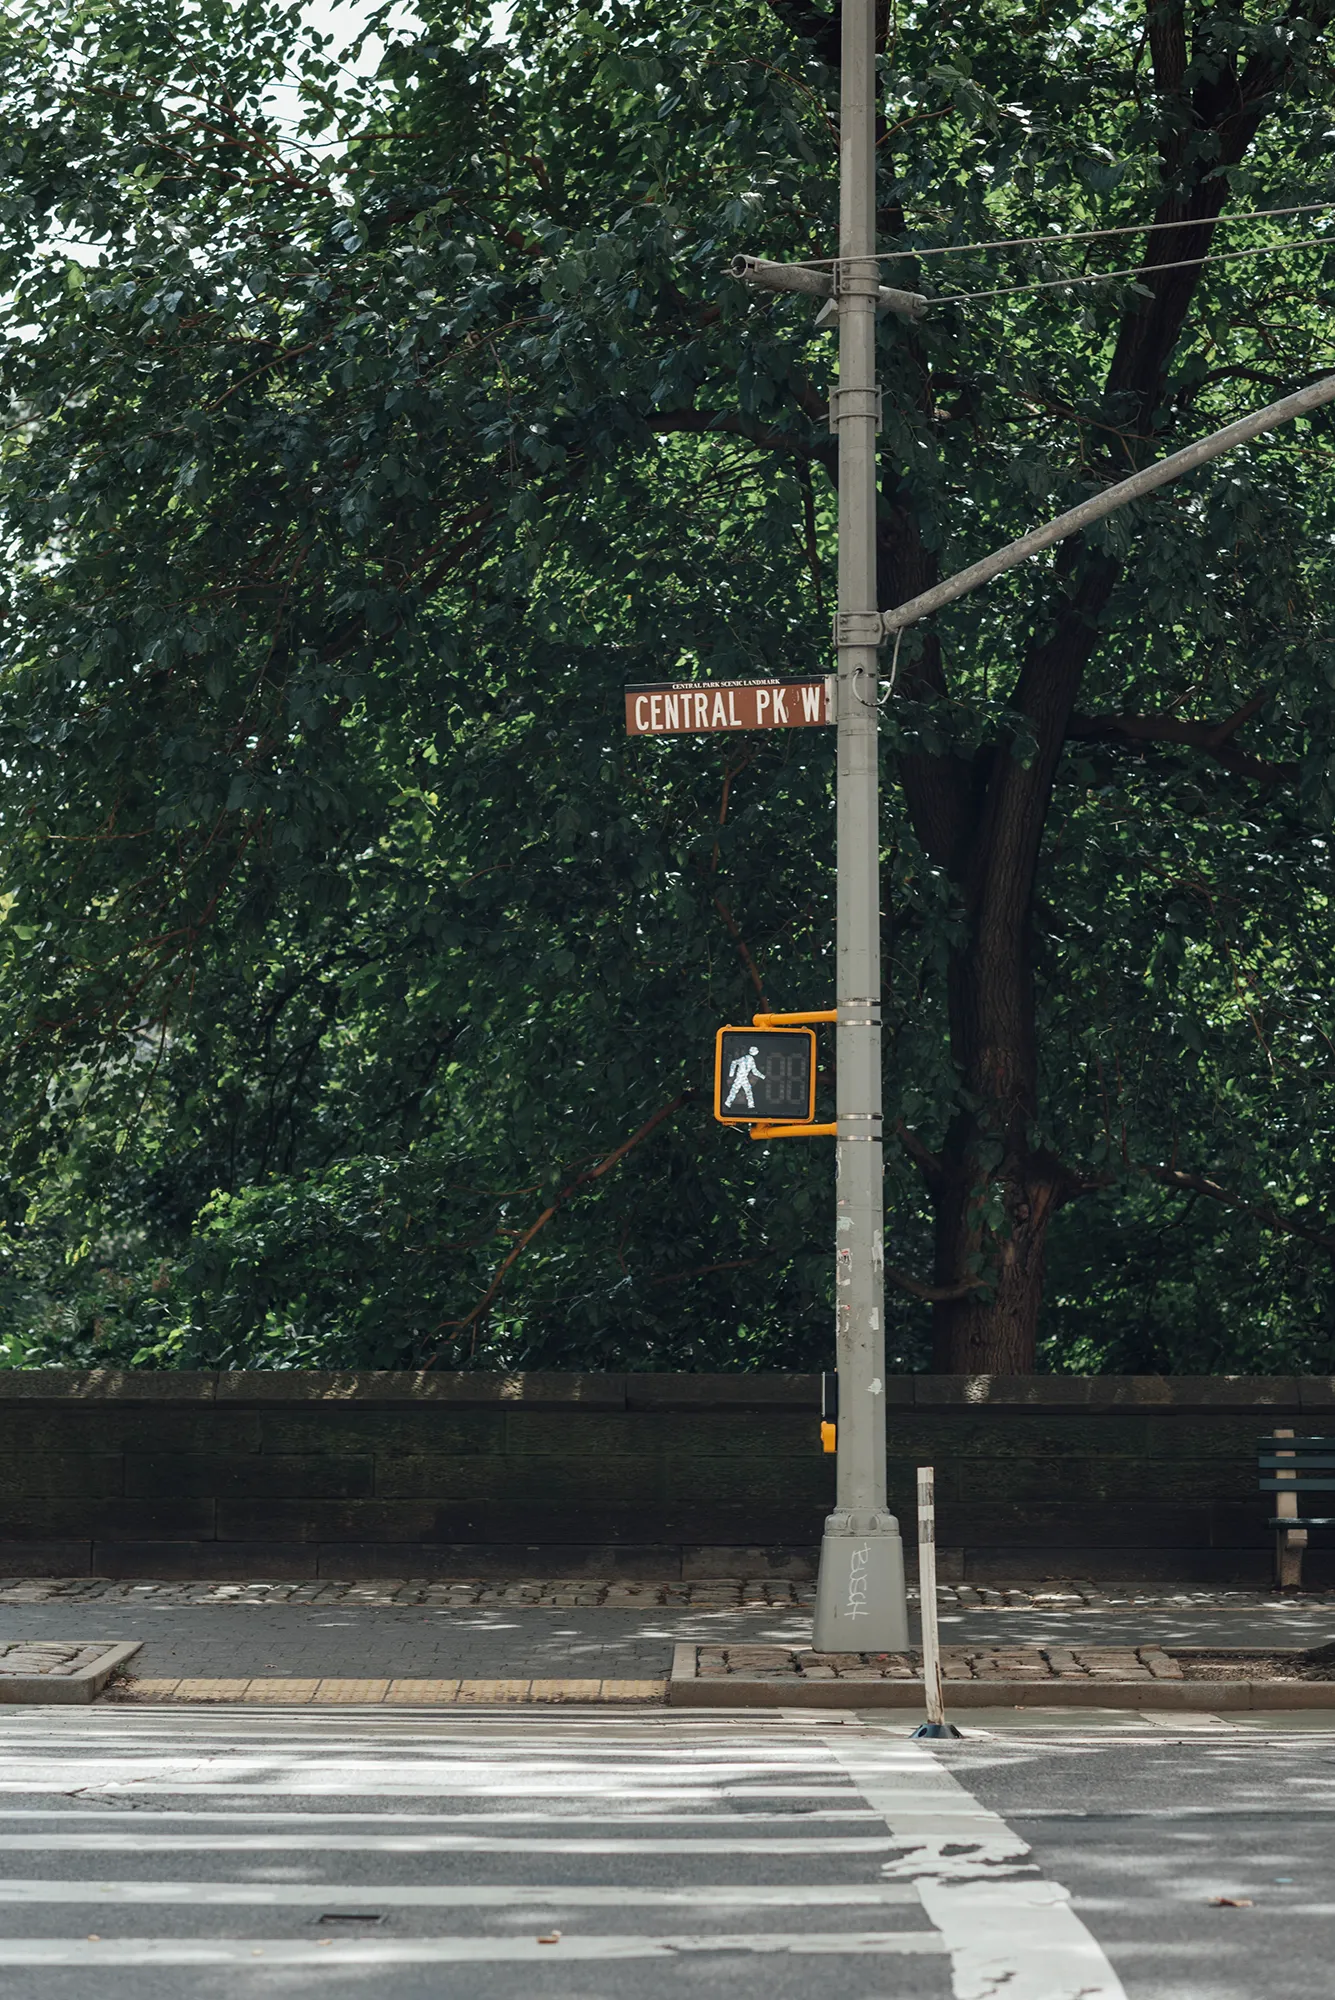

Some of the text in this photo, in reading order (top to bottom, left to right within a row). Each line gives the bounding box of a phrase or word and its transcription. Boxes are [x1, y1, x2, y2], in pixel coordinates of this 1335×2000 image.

[635, 687, 820, 731] CENTRAL PK W
